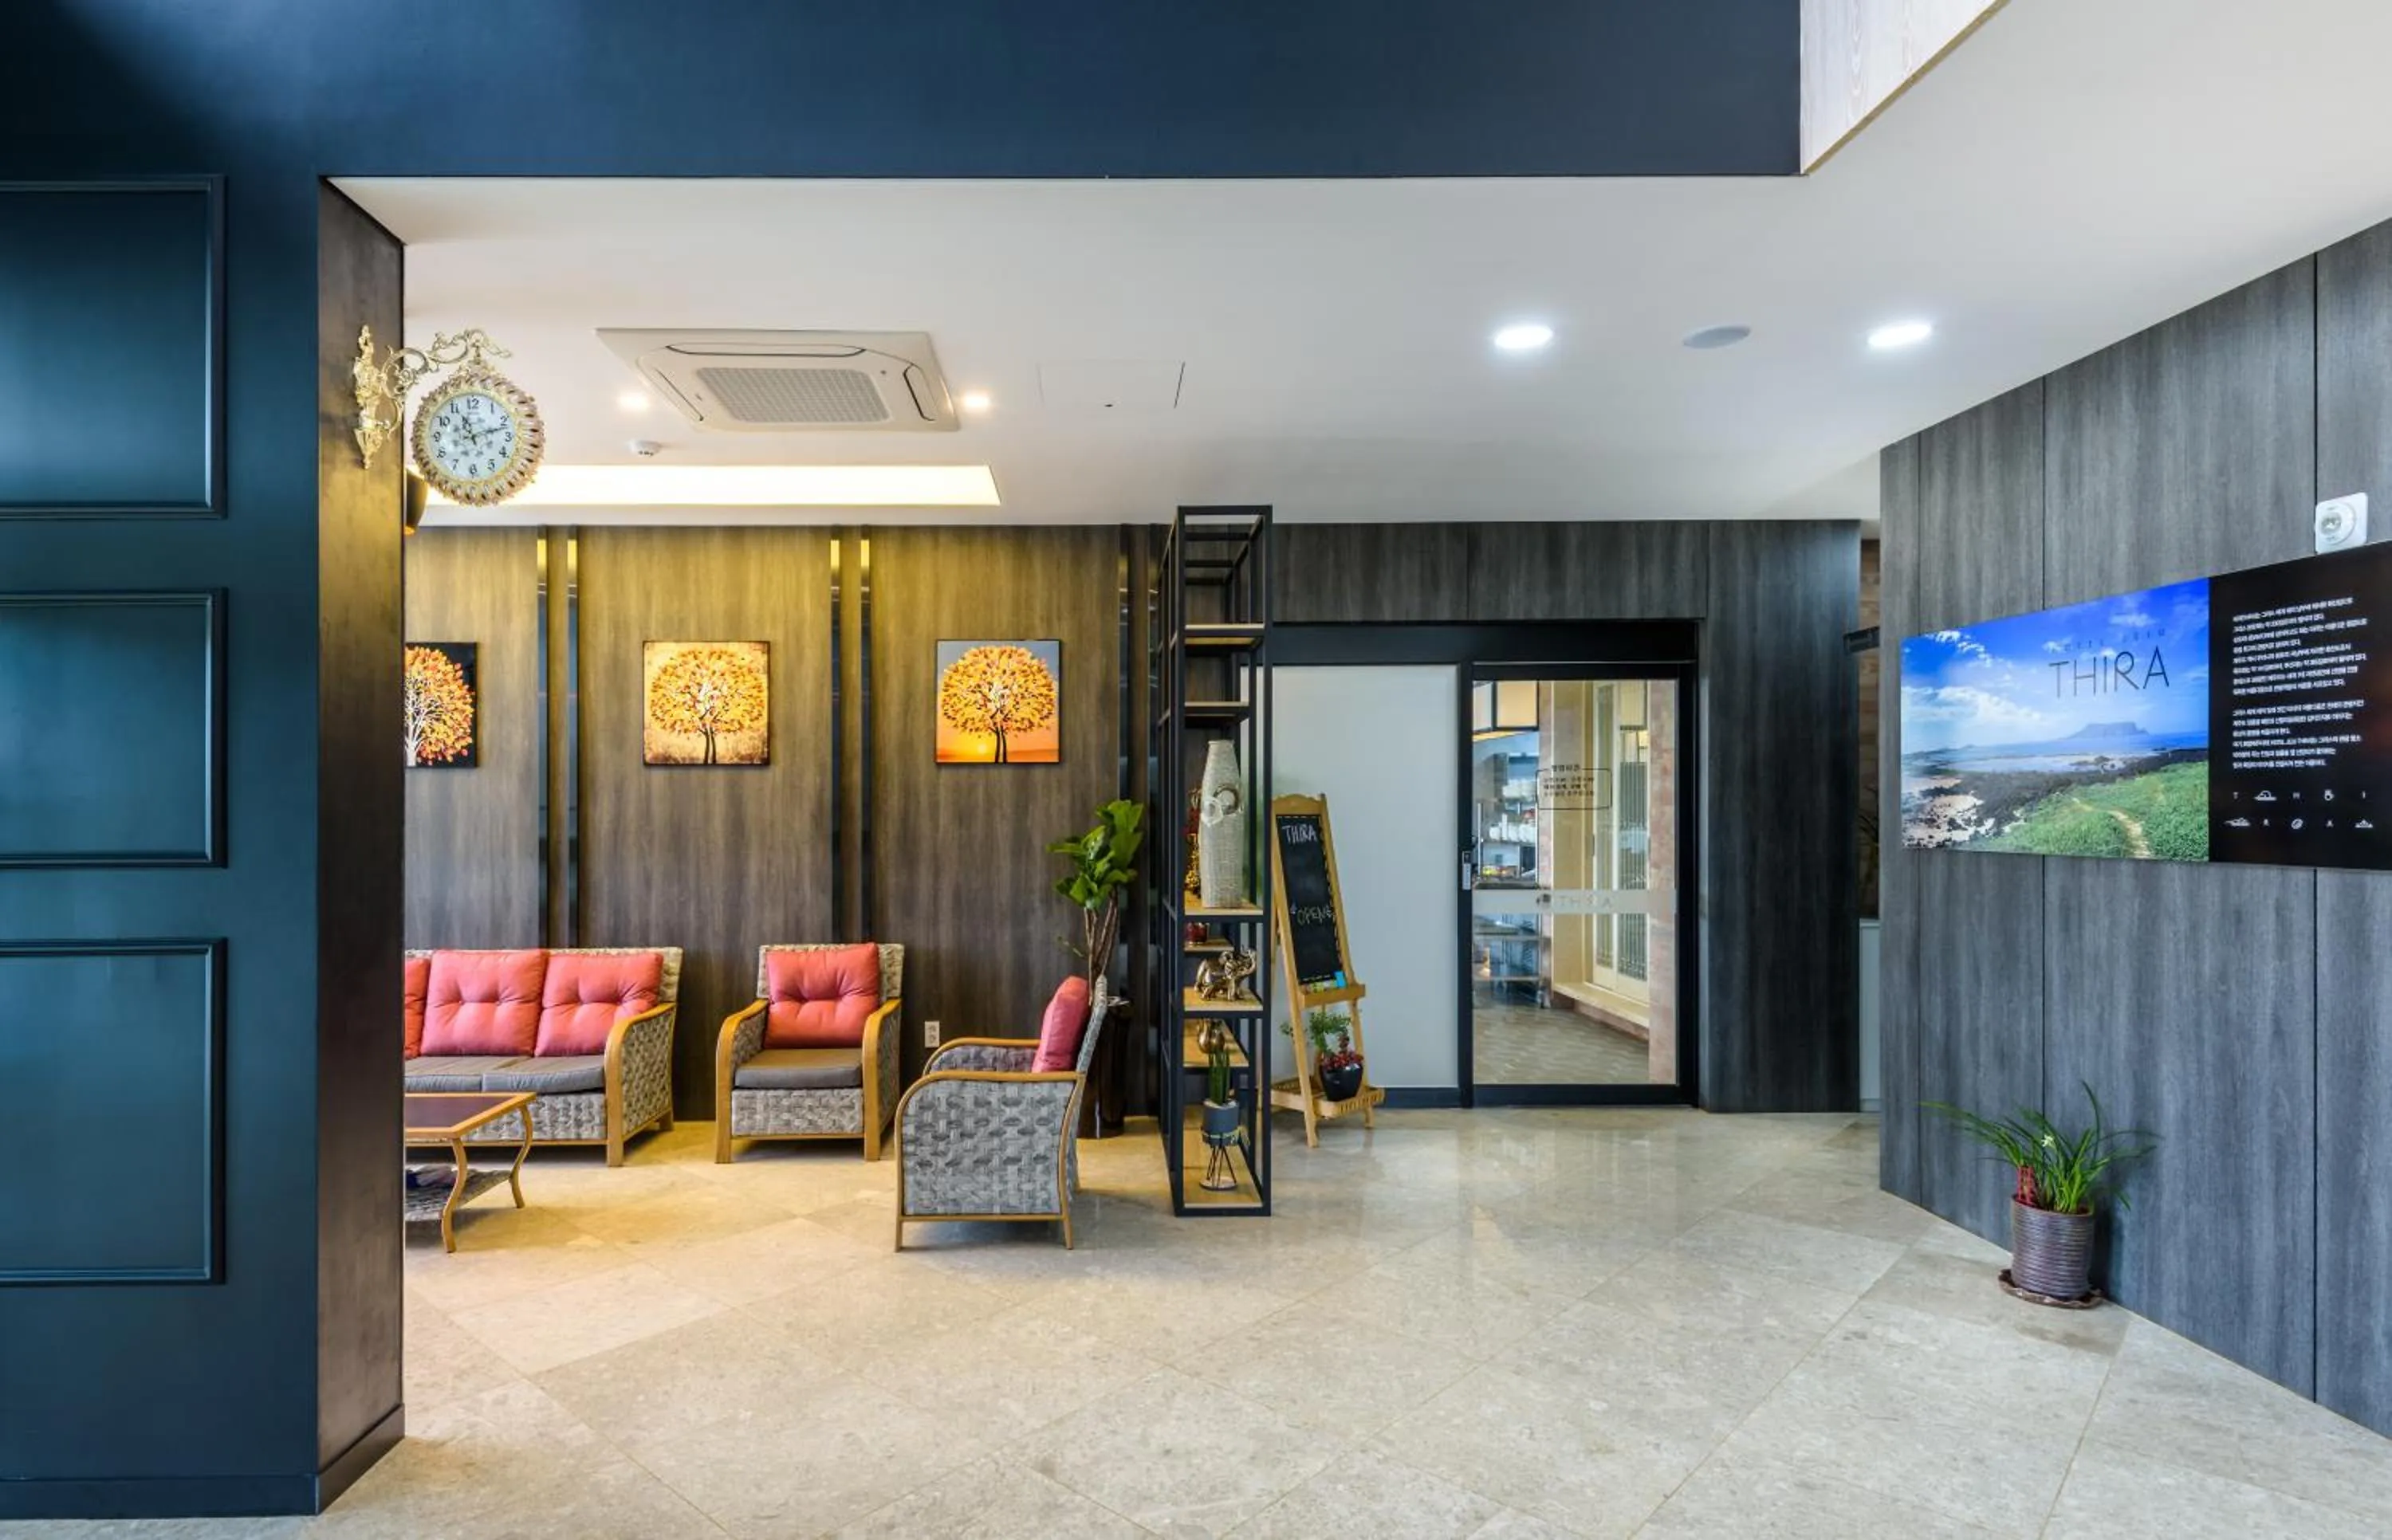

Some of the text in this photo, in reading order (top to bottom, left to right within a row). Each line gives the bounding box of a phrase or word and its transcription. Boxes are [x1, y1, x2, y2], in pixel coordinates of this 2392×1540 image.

[450, 400, 459, 414] 11
[466, 397, 479, 410] 12
[490, 402, 494, 414] 1
[436, 415, 450, 426] 10
[500, 414, 508, 426] 2
[433, 431, 441, 442] 9
[505, 431, 513, 442] 3
[437, 446, 447, 458] 8
[498, 446, 507, 458] 4
[452, 458, 459, 470] 7
[469, 463, 478, 475] 6
[487, 458, 495, 472] 5
[2048, 644, 2170, 698] THIRA
[1282, 823, 1317, 844] THIRA
